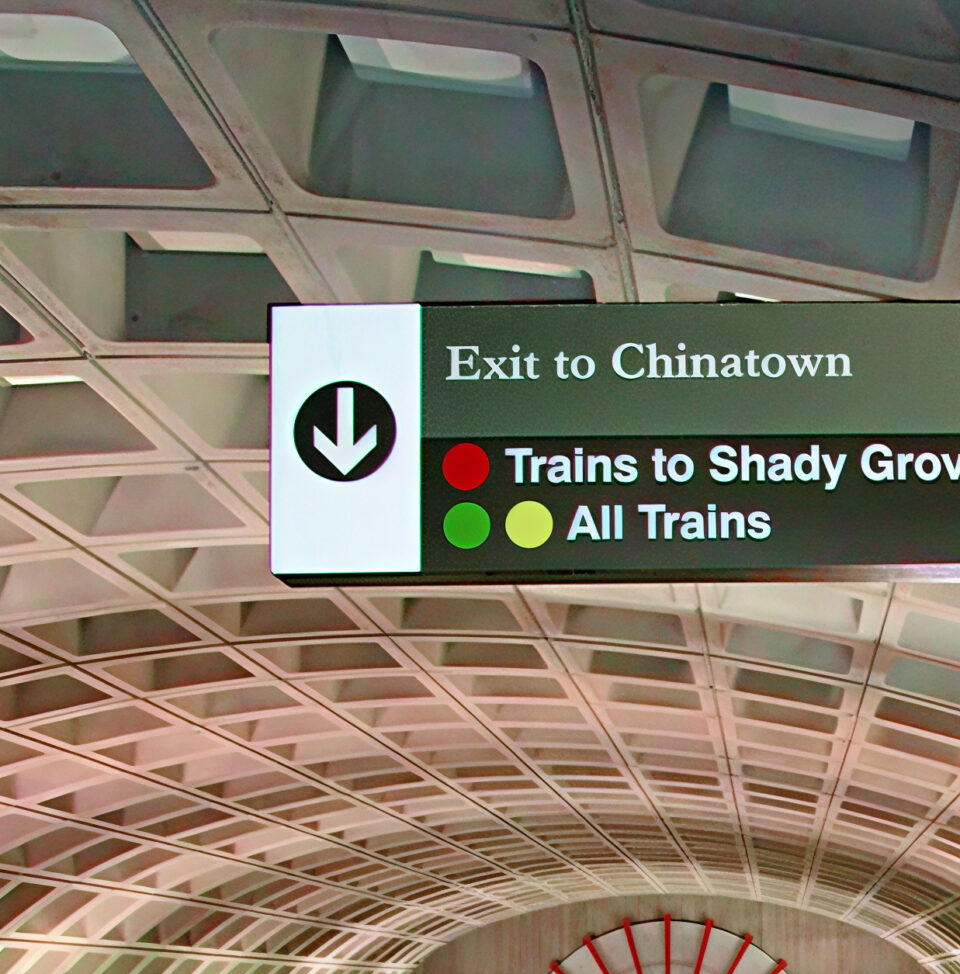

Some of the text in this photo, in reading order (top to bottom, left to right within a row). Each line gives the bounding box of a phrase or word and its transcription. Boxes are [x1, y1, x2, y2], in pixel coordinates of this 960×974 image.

[445, 342, 853, 380] Exit to Chinatown
[505, 447, 638, 484] Trains
[651, 448, 694, 483] to
[709, 444, 848, 491] Shady
[566, 503, 771, 540] All Trains
